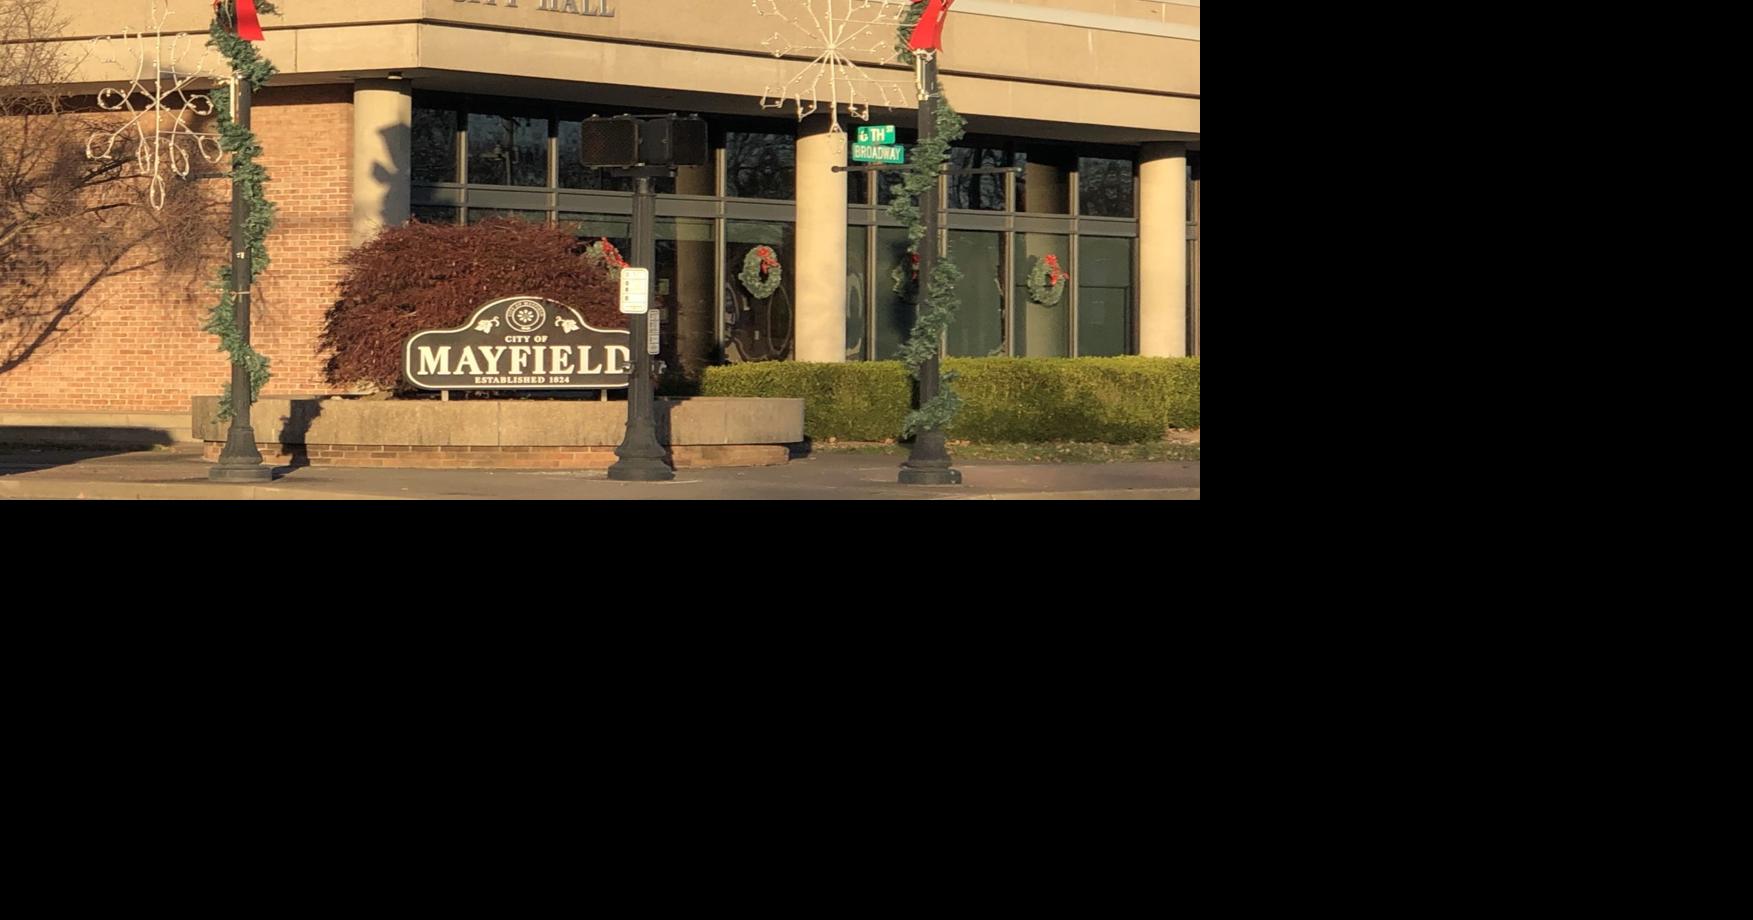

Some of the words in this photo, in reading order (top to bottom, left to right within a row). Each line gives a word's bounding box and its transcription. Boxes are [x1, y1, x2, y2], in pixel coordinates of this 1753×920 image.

[855, 145, 900, 161] BROADWAY
[505, 335, 531, 343] CITY
[534, 335, 548, 343] OF
[417, 345, 631, 375] MAYFIELD
[475, 376, 546, 384] ESTABLISHED
[549, 376, 570, 384] 1824
